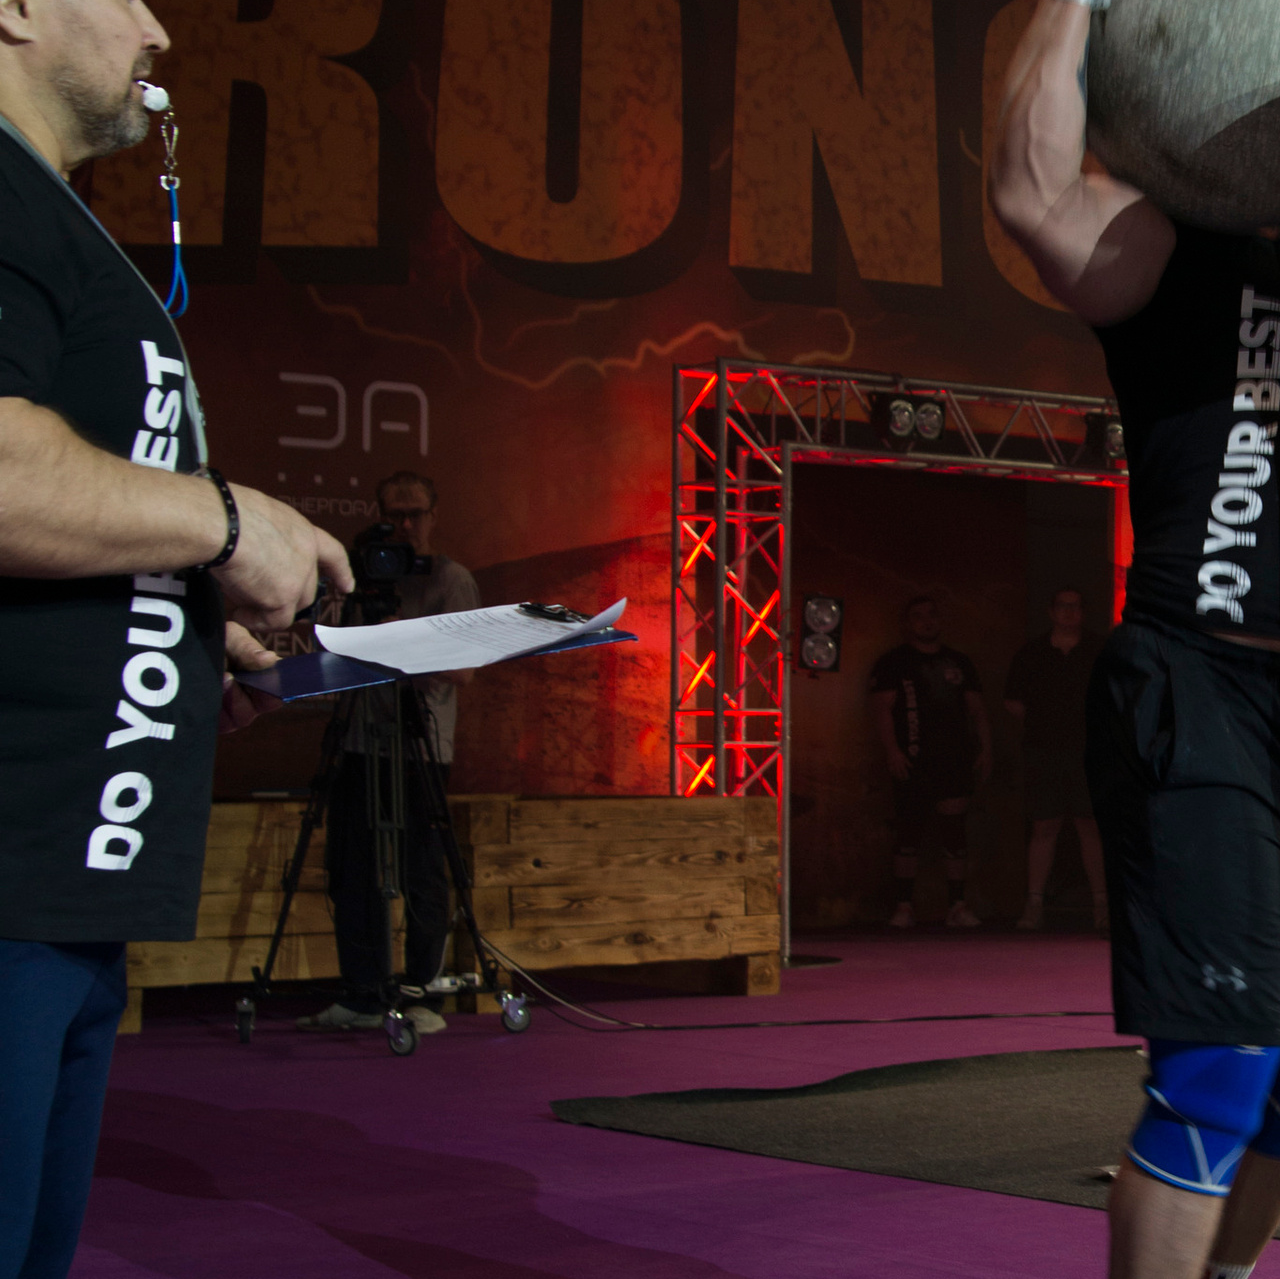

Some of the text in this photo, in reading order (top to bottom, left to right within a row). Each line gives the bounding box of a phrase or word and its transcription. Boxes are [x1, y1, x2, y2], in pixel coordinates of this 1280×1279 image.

[86, 771, 154, 871] DO
[132, 339, 186, 474] EST
[1202, 420, 1280, 556] YOUR
